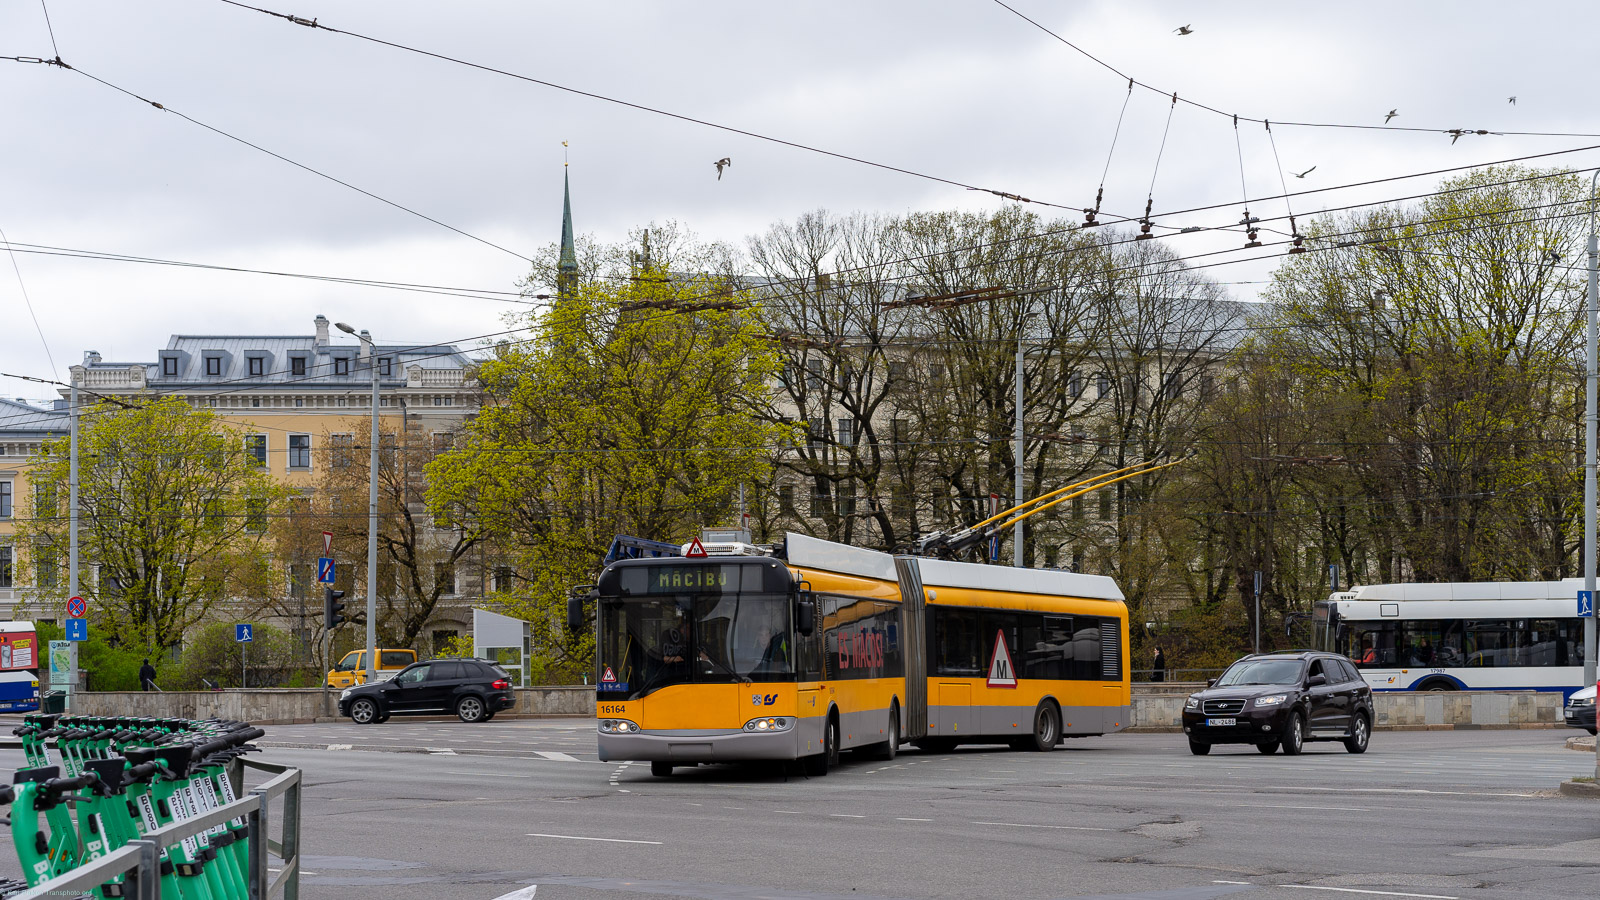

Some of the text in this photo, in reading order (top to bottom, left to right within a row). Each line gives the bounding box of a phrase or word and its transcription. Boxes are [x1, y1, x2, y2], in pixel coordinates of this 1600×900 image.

[838, 631, 849, 669] ES
[996, 659, 1008, 679] M
[601, 705, 626, 714] 16164
